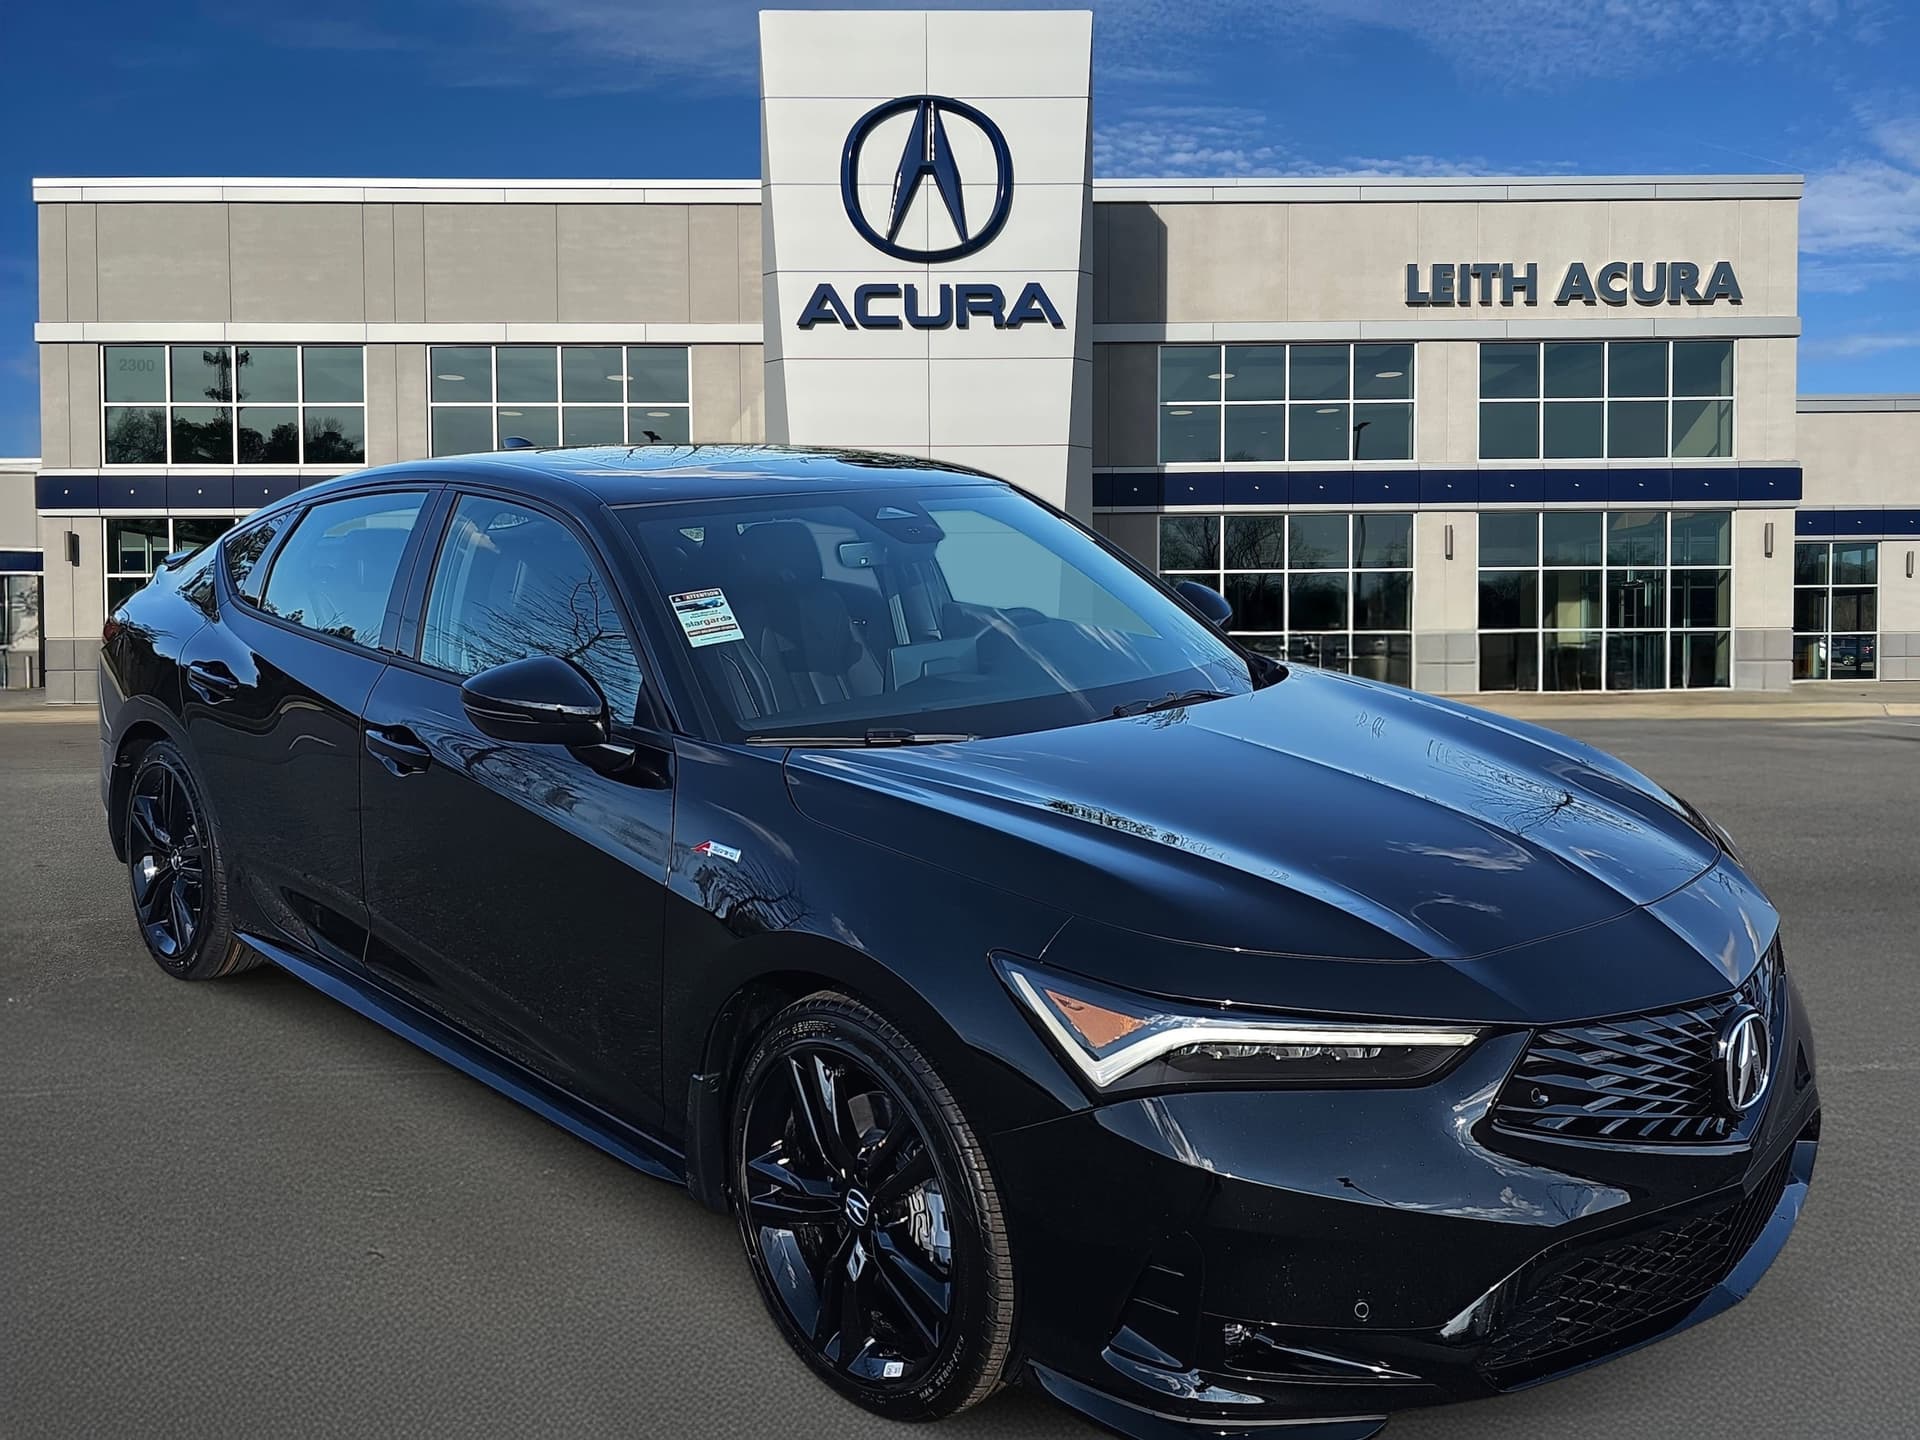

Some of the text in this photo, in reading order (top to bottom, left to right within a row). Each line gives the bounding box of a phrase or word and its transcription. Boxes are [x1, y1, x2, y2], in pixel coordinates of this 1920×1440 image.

[797, 282, 1067, 330] ACURA
[1405, 261, 1744, 307] LEITH ACURA
[119, 358, 154, 372] 2300
